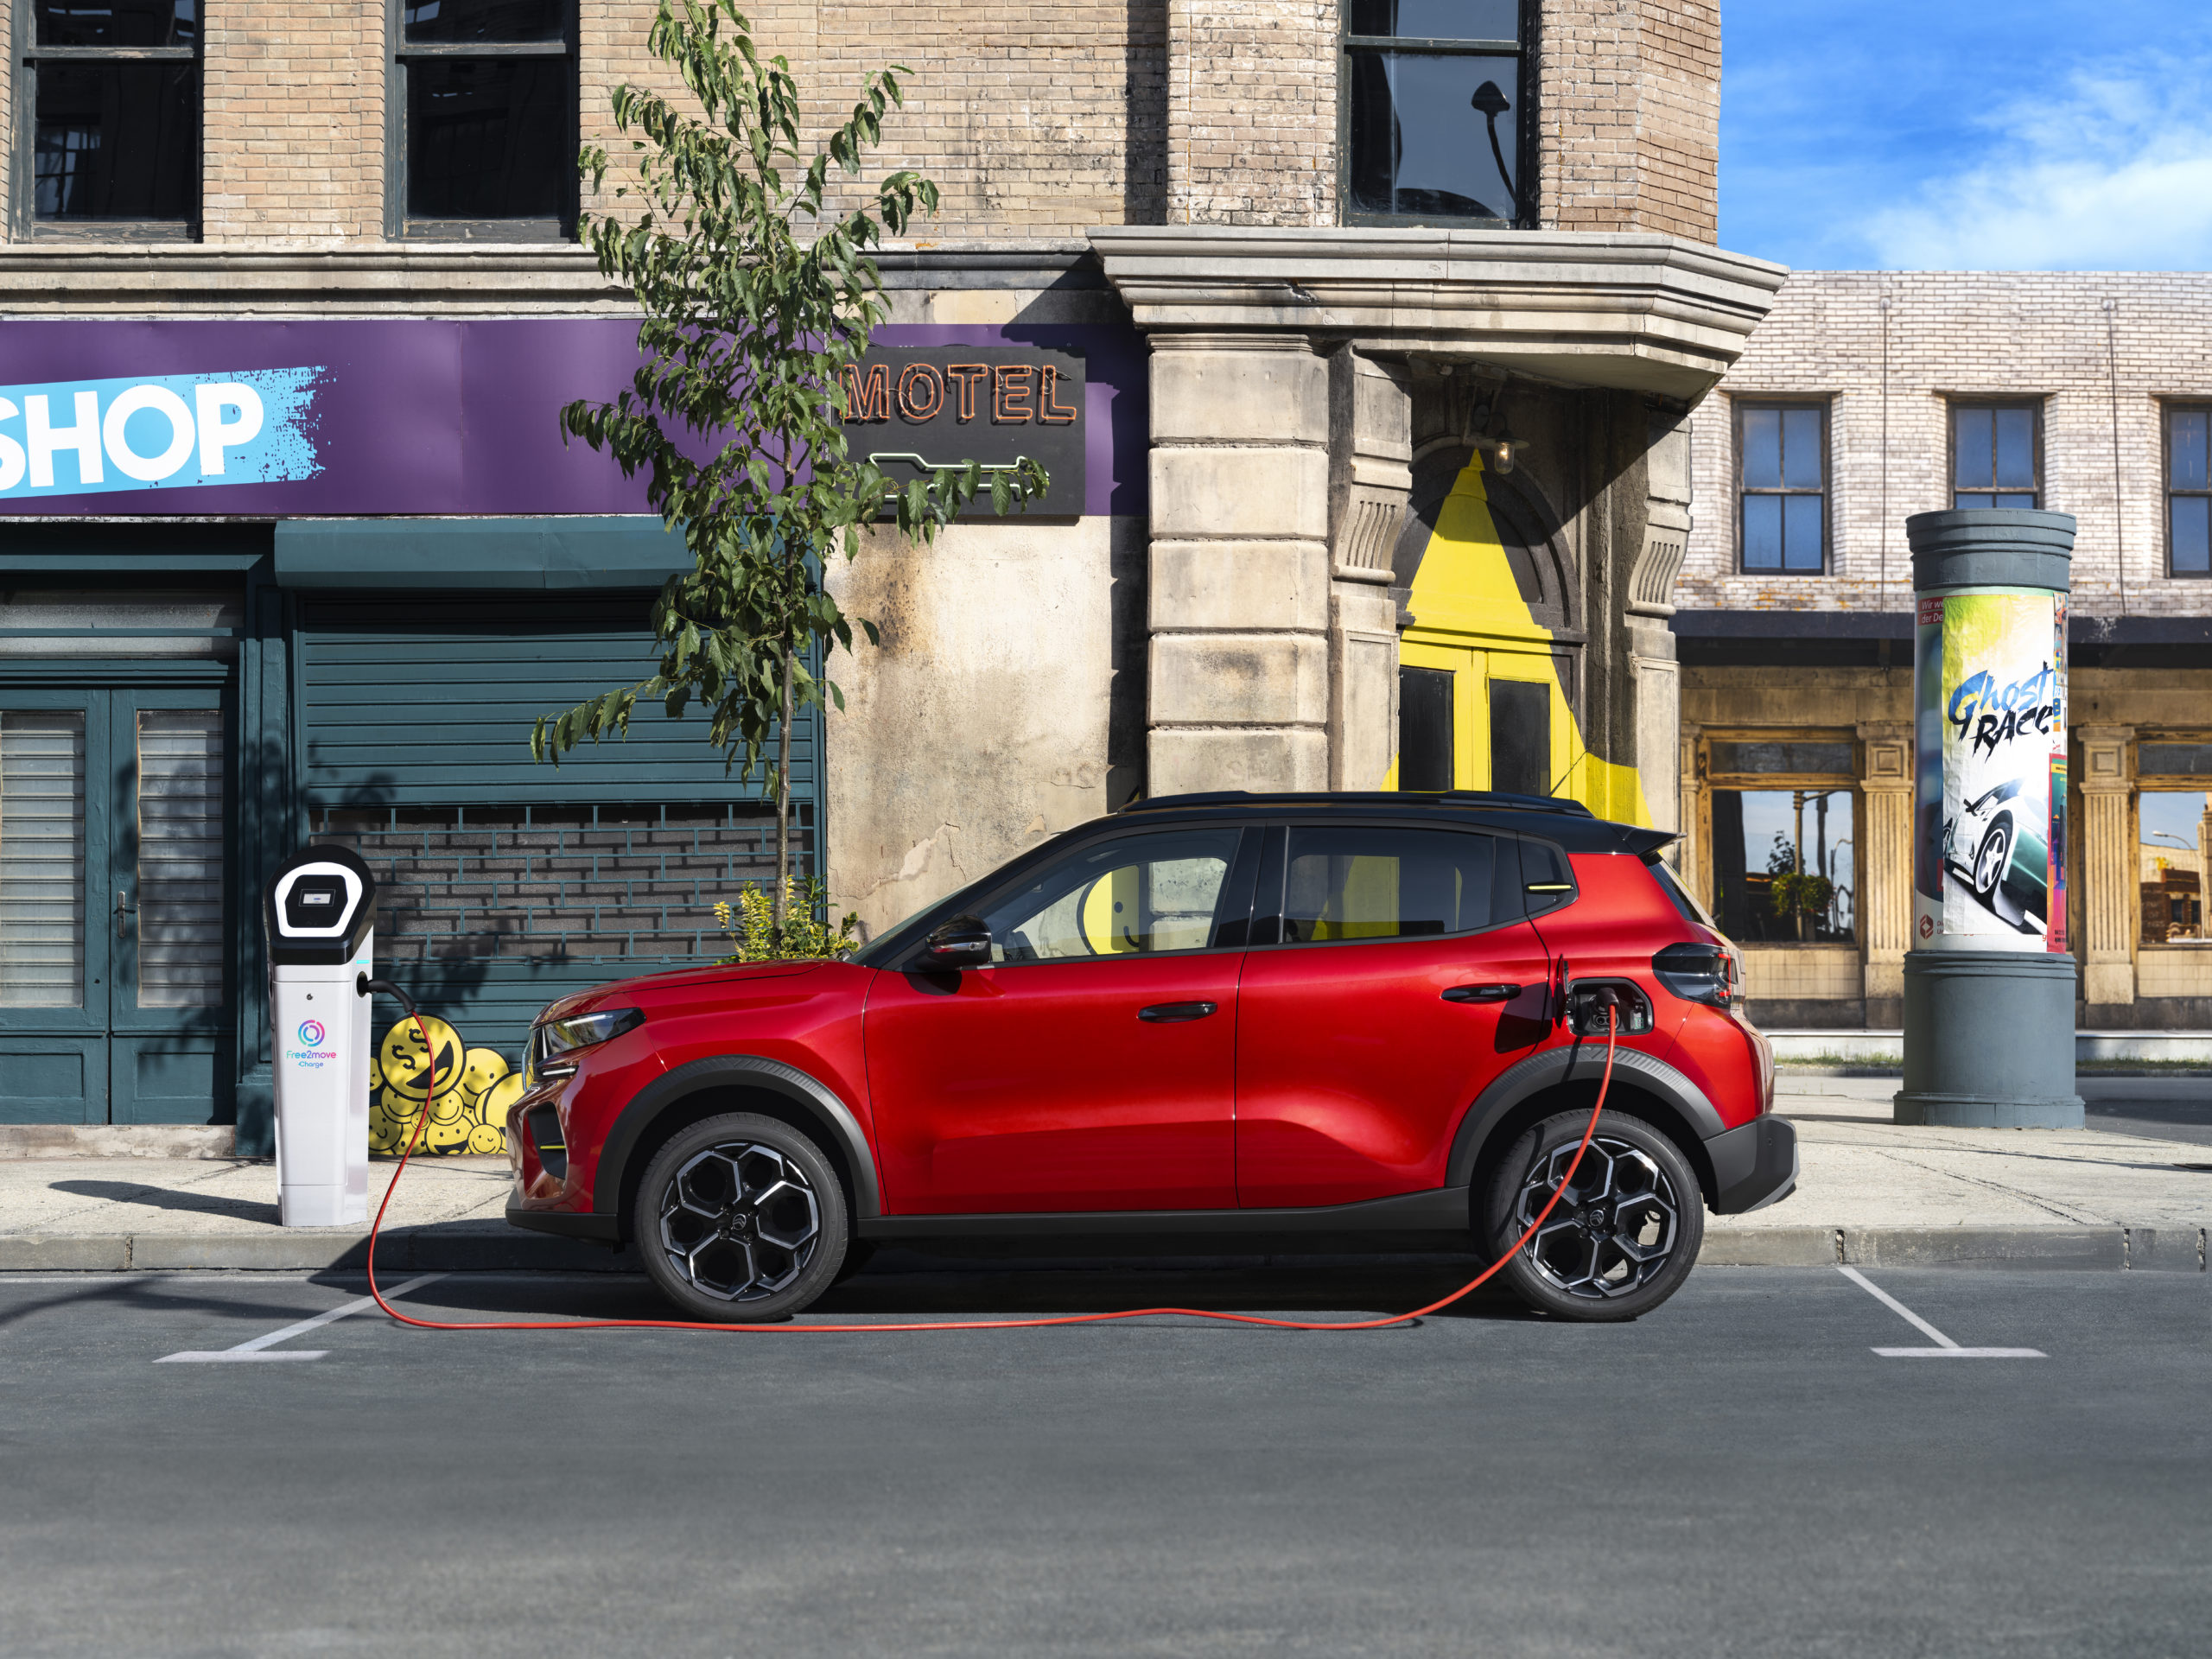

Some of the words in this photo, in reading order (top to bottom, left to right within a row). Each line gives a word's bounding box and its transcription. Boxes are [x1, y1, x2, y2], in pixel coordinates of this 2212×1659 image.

[839, 363, 1077, 420] MOTEL
[1921, 613, 1932, 624] der
[286, 1050, 337, 1059] Free2move
[298, 1060, 324, 1069] Charge
